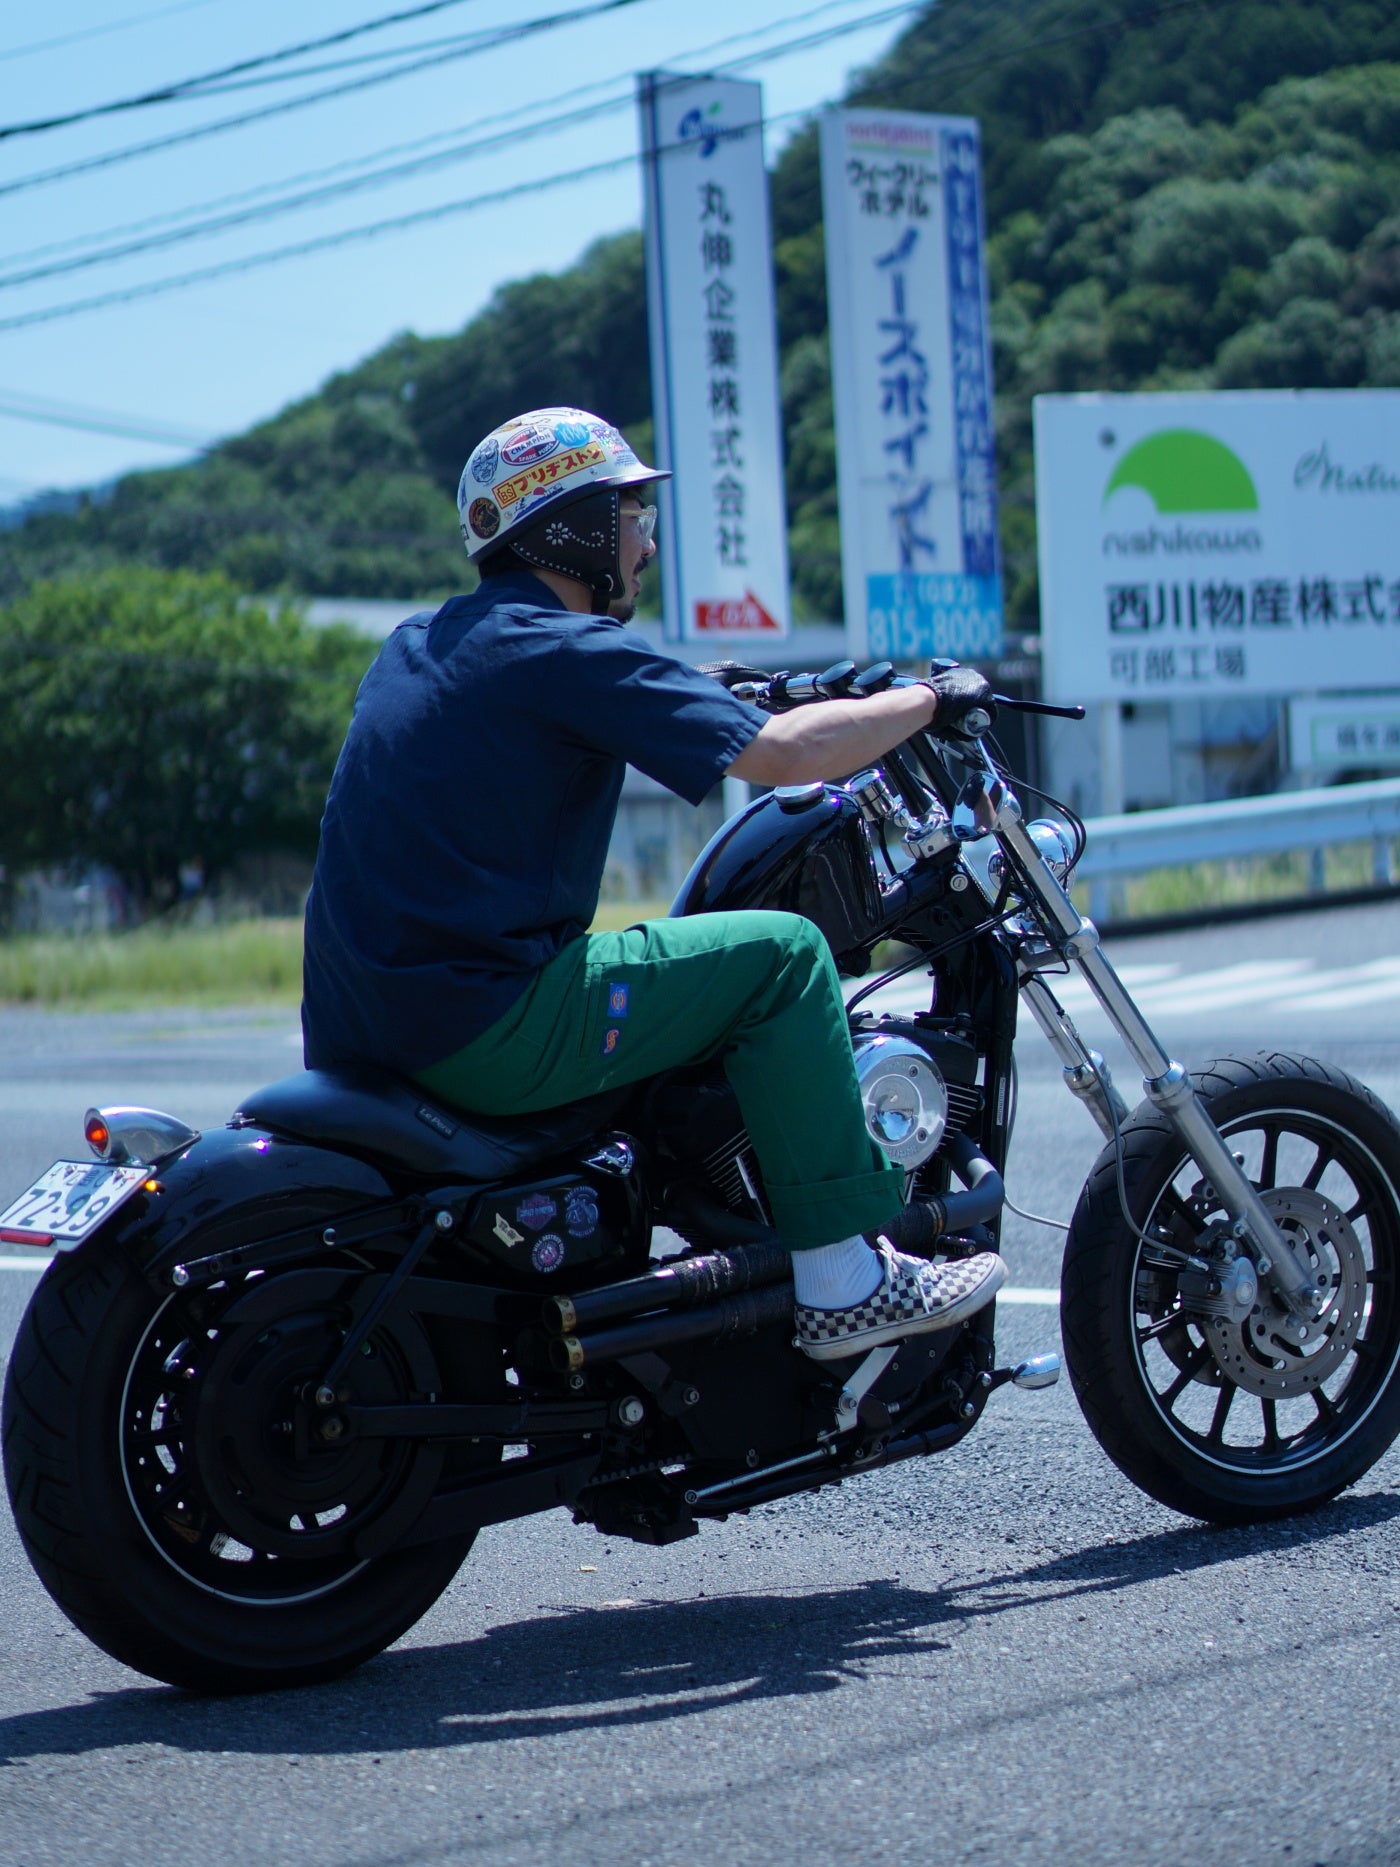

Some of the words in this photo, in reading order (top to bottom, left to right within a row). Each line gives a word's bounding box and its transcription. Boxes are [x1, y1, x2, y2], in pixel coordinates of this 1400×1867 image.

[846, 159, 940, 187] ウィークリー
[859, 190, 932, 219] ホテル
[511, 433, 550, 455] CHAMPION
[519, 455, 537, 463] SPARK
[501, 489, 513, 501] BS
[513, 449, 601, 491] ブリヂストン
[1106, 574, 1400, 633] 西川物産株式
[869, 609, 1000, 657] 815-8000
[1111, 645, 1247, 685] 可部工場
[1, 1189, 110, 1231] 72-99
